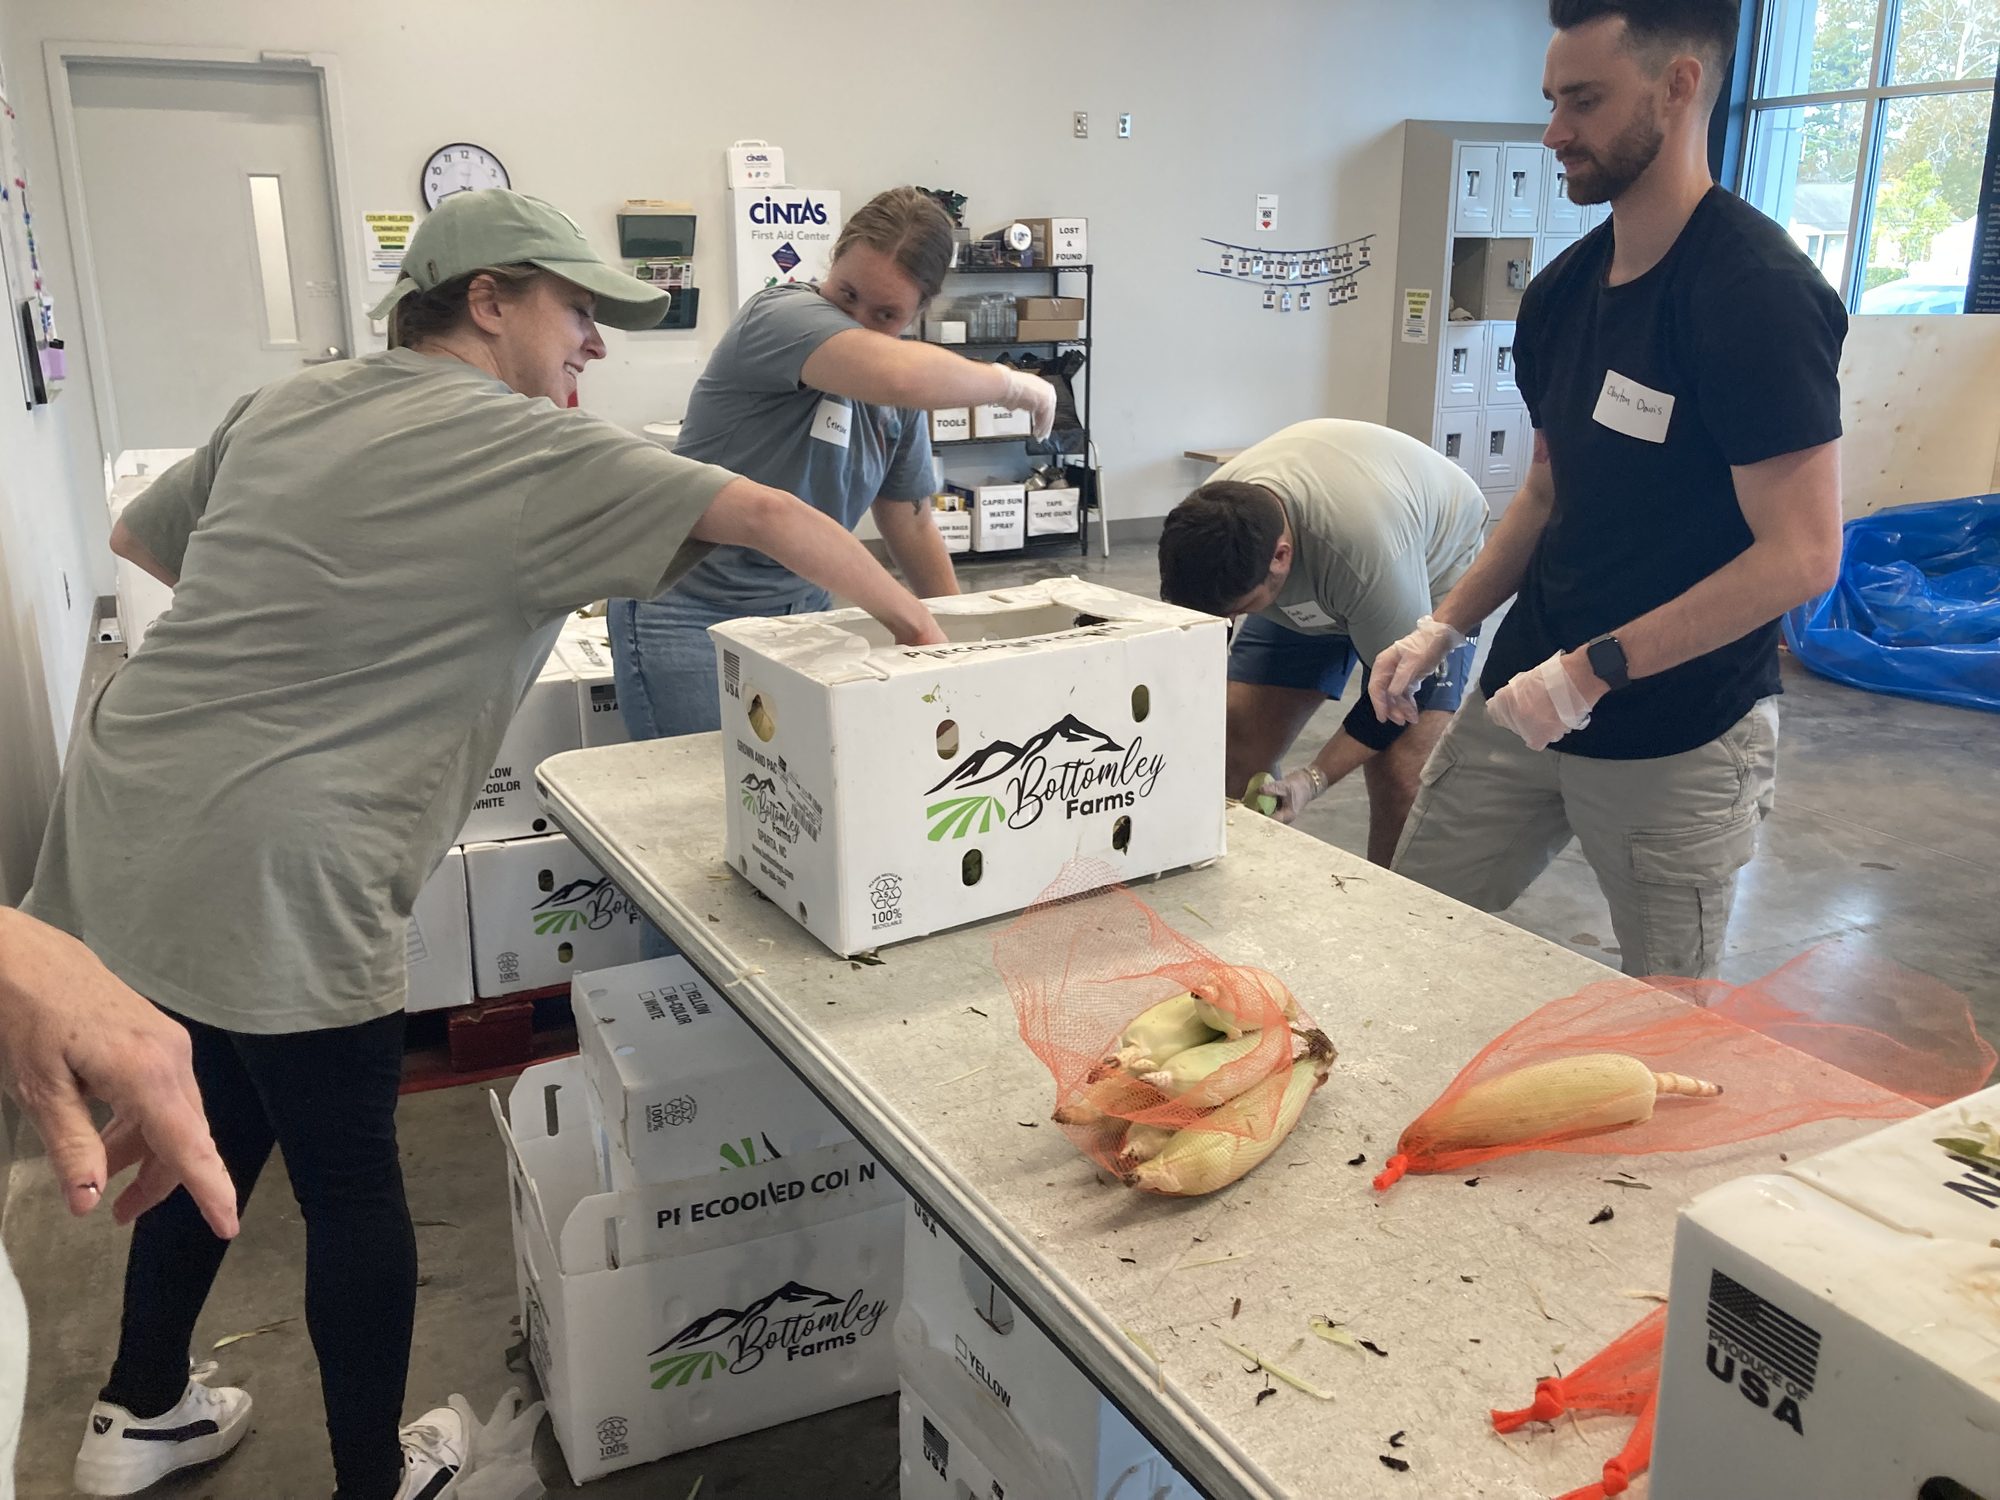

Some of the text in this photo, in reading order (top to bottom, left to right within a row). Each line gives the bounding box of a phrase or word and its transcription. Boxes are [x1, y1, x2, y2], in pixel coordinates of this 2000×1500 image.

[443, 154, 452, 163] 11
[460, 150, 469, 159] 12
[432, 167, 442, 175] 10
[490, 168, 497, 178] 2
[431, 183, 438, 192] 9
[751, 230, 830, 241] First Aid Center
[1637, 398, 1662, 415] Davis
[936, 419, 966, 427] TOOLS
[725, 680, 740, 700] USA
[593, 703, 619, 713] USA
[737, 739, 778, 774] GROWN AND PAC
[1006, 736, 1166, 829] Bottomley
[473, 797, 505, 810] WHITE
[1066, 791, 1135, 819] Farms
[757, 790, 800, 844] Bottomley
[872, 908, 902, 924] 100%
[643, 999, 666, 1020] WHITE
[664, 994, 692, 1026] BI-COLOR
[685, 990, 712, 1015] YELLOW
[651, 1103, 664, 1131] 100%
[914, 1203, 937, 1238] USA
[728, 1289, 888, 1374] Bottomley
[787, 1332, 856, 1361] Farms
[1709, 1329, 1808, 1401] PRODUCE OF
[968, 1351, 1011, 1407] YELLOW
[1706, 1343, 1804, 1436] USA
[923, 1446, 948, 1482] USA
